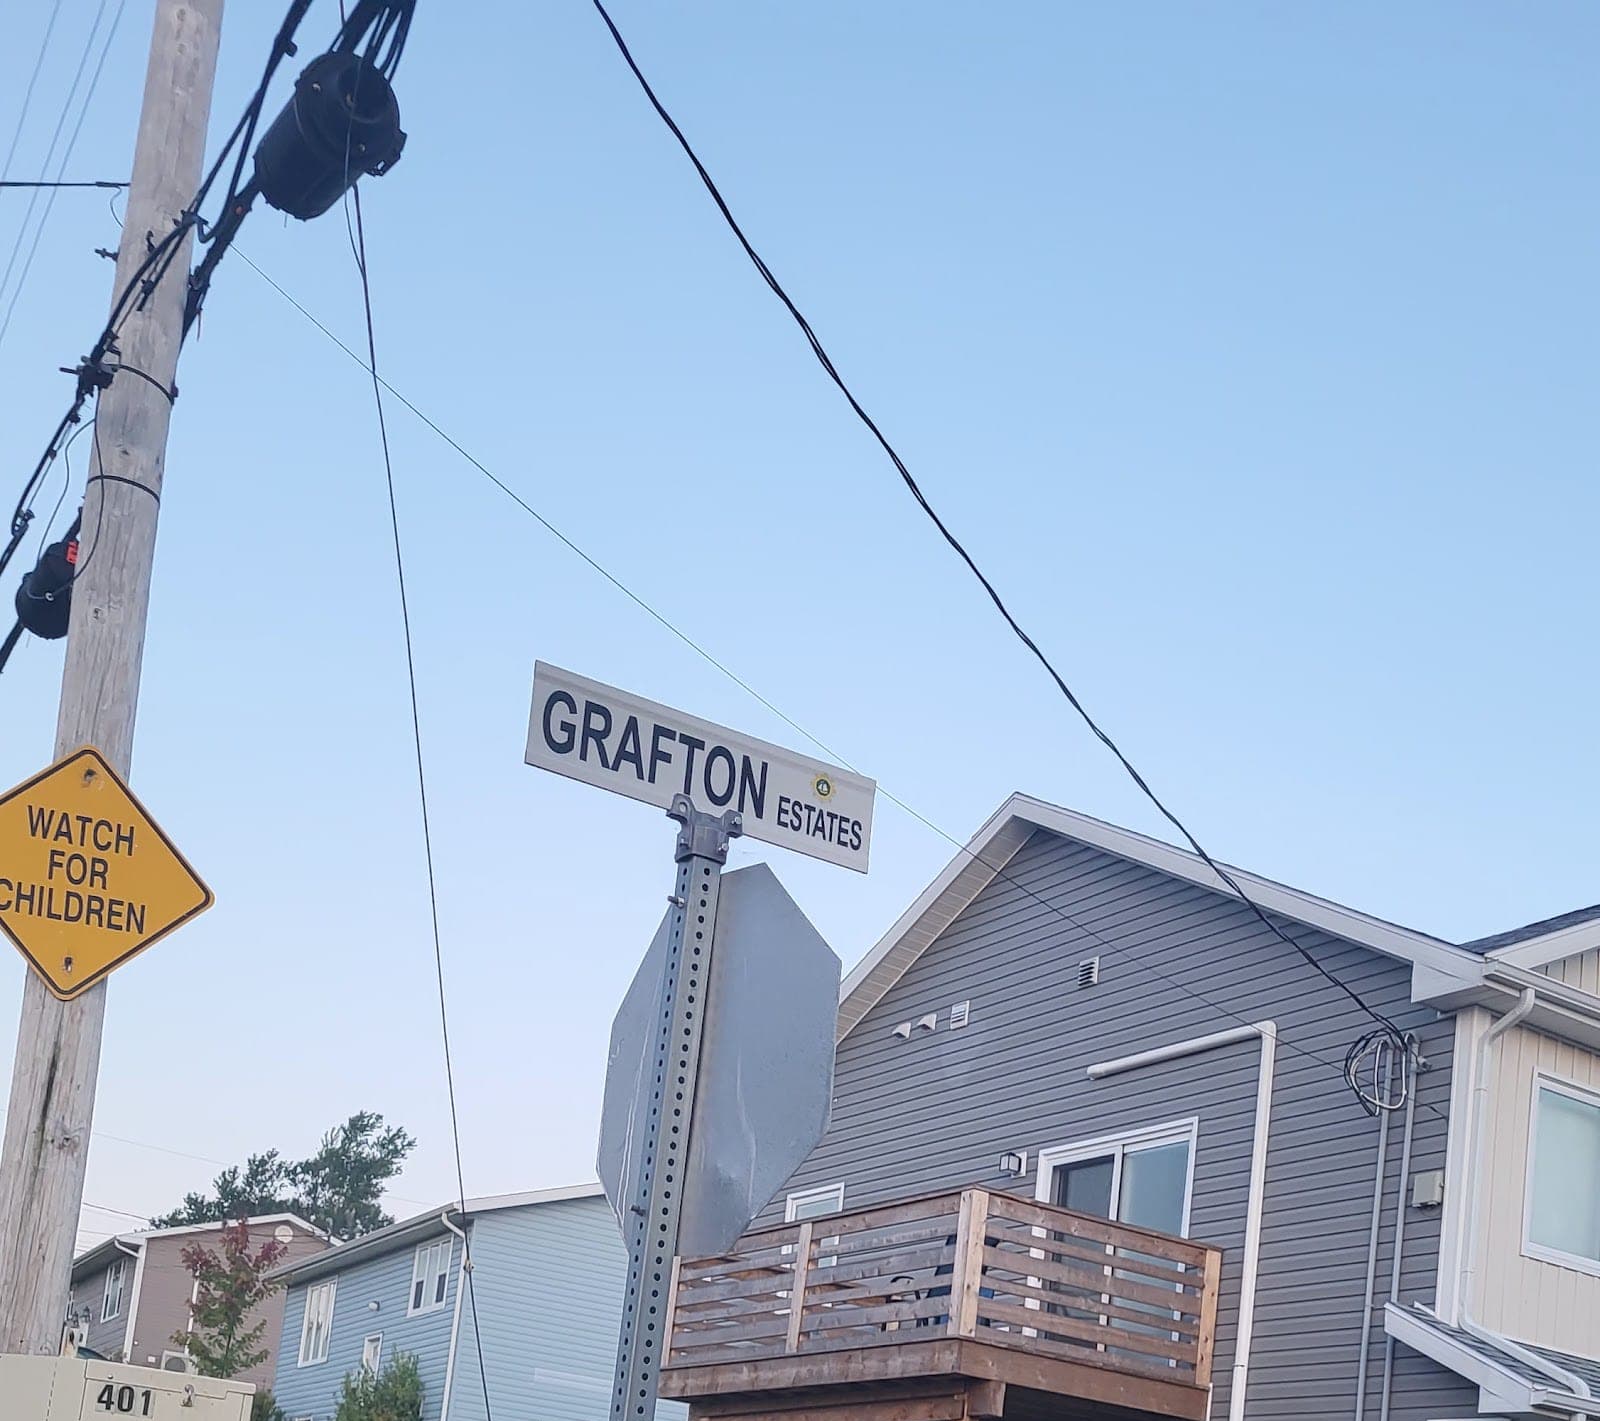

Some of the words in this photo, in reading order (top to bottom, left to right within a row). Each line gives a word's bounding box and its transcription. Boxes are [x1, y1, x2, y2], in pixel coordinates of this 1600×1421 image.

[543, 690, 768, 819] GRAFTON
[777, 795, 862, 851] ESTATES
[28, 805, 135, 856] WATCH
[48, 850, 109, 890] FOR
[0, 878, 146, 934] CHILDREN
[97, 1384, 151, 1416] 401
